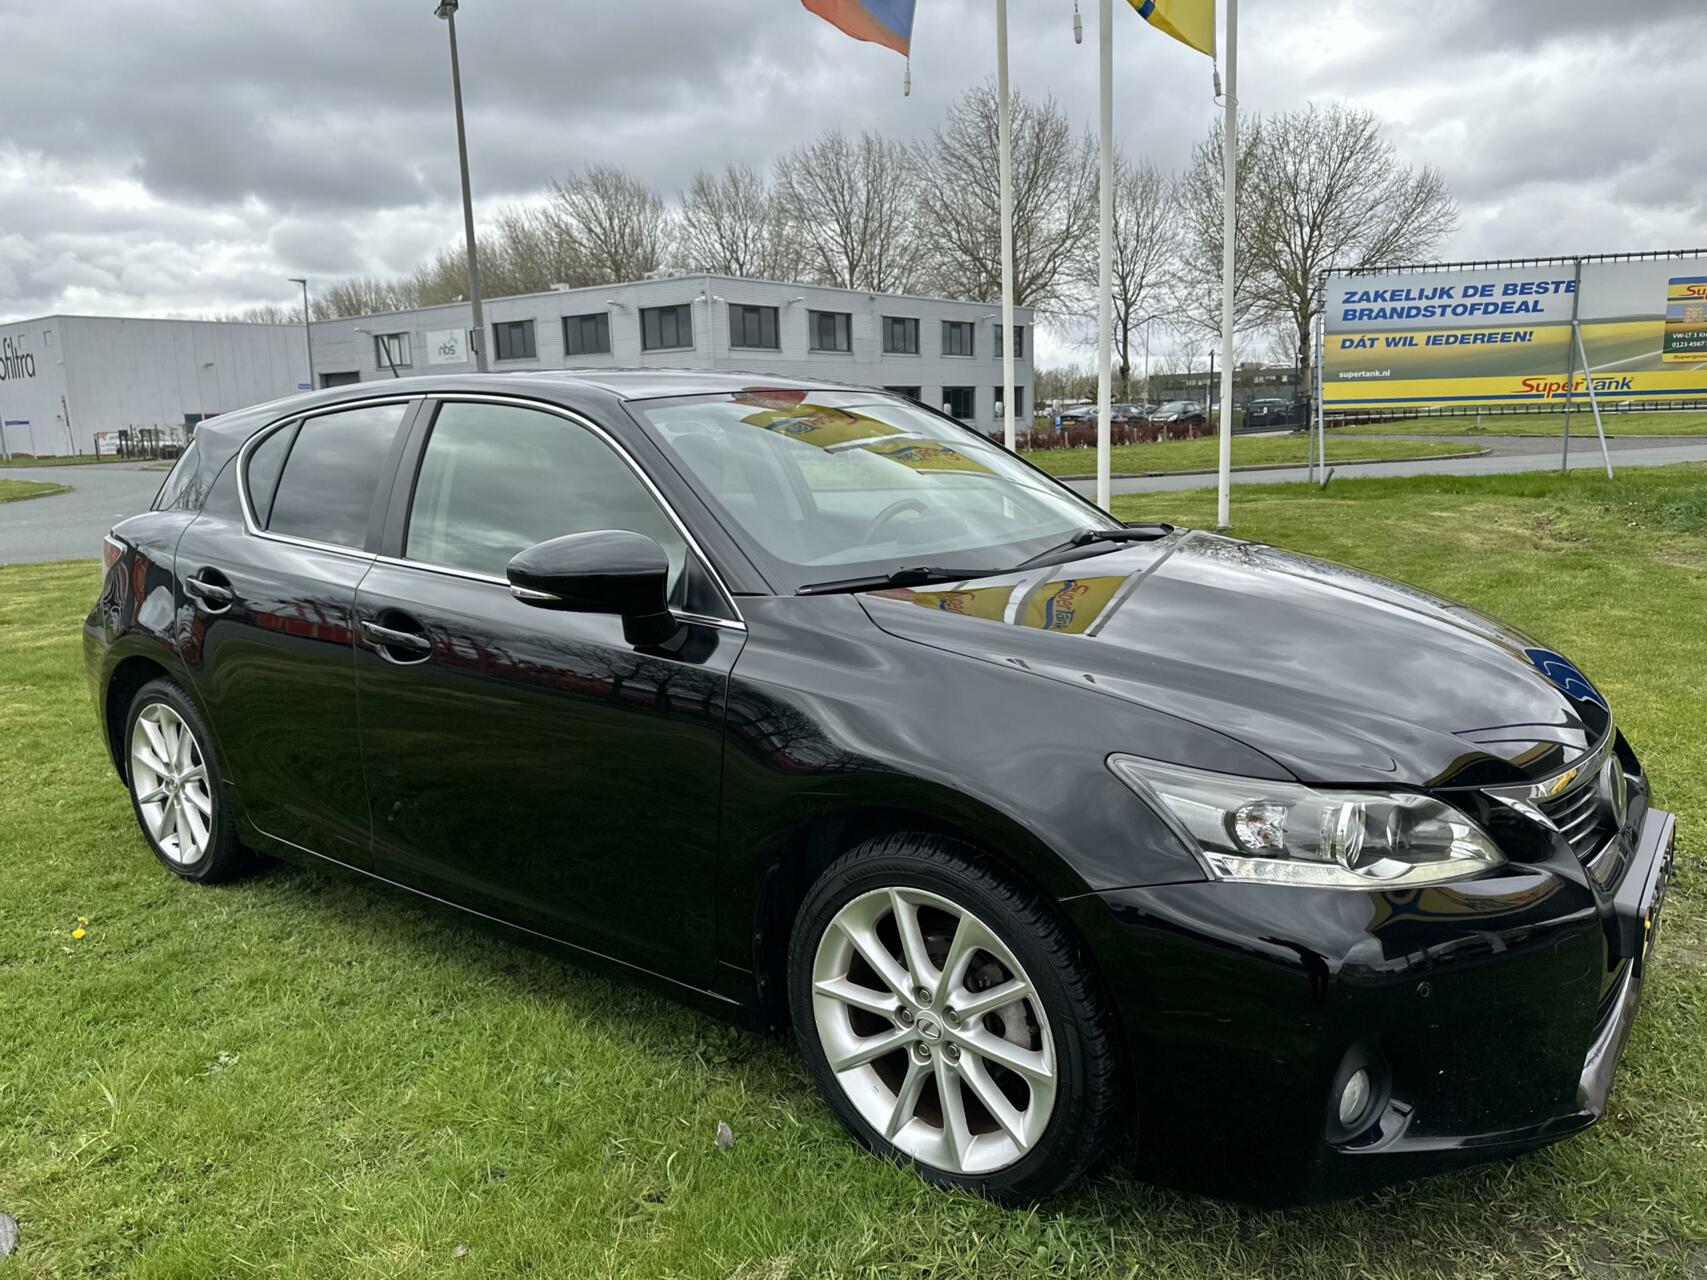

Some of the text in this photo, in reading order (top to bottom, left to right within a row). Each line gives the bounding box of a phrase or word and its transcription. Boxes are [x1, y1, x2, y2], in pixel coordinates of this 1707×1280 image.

[1342, 280, 1580, 304] ZAKELIJK DE BESTE
[1342, 300, 1544, 321] BRANDSTOFDEAL
[1340, 331, 1534, 349] DÁT WIL IEDEREEN!
[1339, 369, 1391, 378] supertank.nl
[1510, 377, 1633, 398] SuperTank
